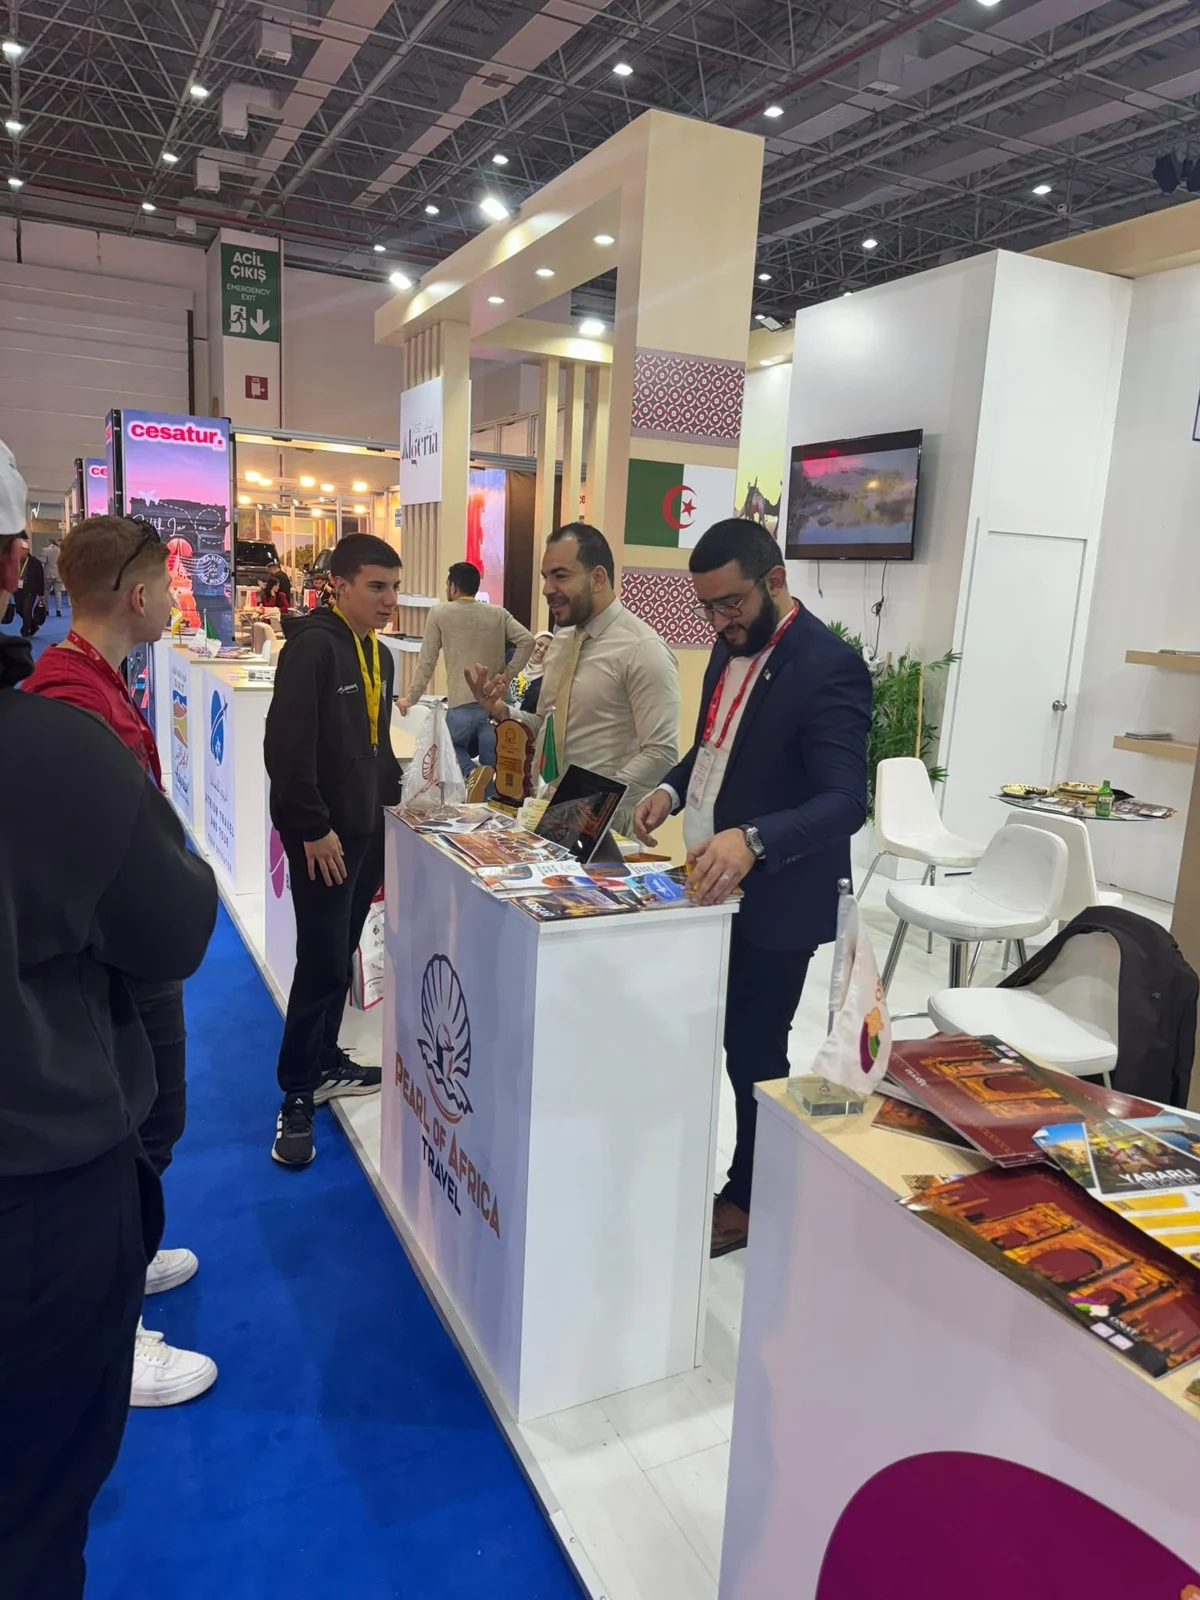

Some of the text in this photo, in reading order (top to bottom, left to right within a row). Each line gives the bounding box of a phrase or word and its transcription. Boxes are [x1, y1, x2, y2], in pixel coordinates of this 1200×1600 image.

[233, 251, 264, 267] ACİL
[230, 264, 267, 283] ÇIKIŞ
[226, 283, 271, 296] EMERGENCY
[241, 293, 257, 302] EXIT
[402, 428, 438, 468] Algeria
[394, 1051, 500, 1240] PEARL OF AFRICA
[421, 1134, 461, 1216] TRAVEL
[1118, 1168, 1197, 1184] YARARLI
